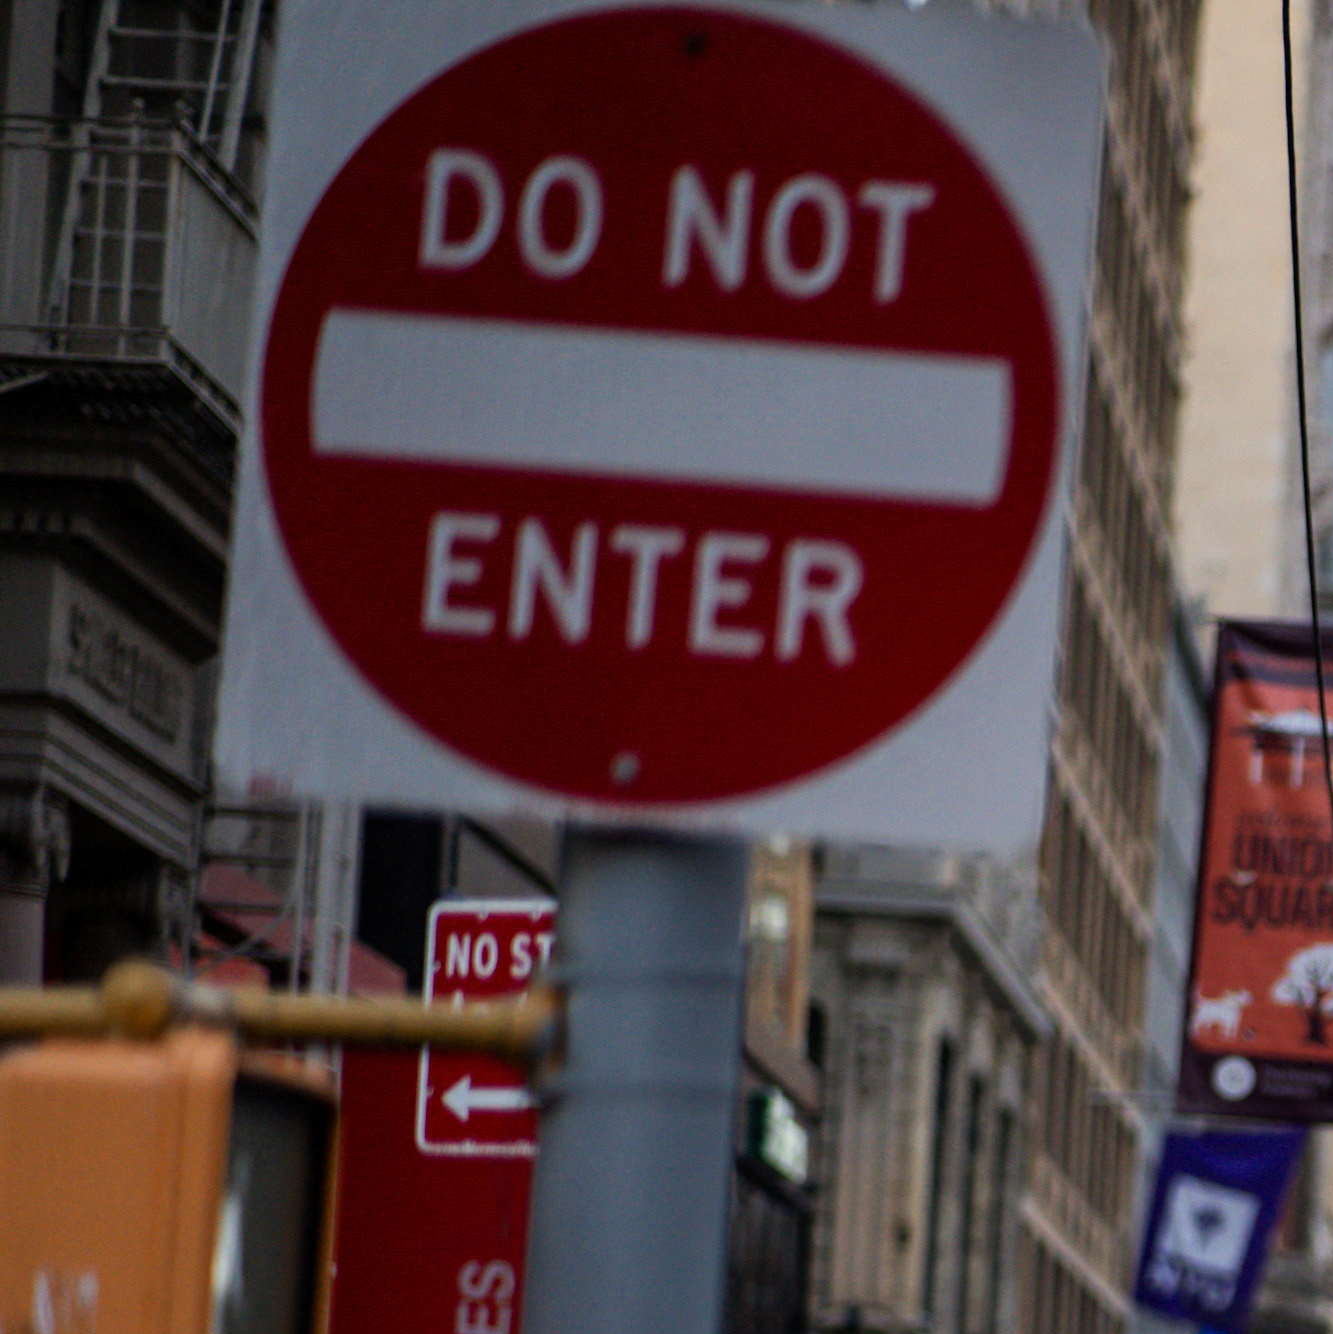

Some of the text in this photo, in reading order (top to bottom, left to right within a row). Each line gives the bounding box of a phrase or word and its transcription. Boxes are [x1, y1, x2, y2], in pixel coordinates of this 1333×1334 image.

[418, 147, 937, 306] DO NOT
[420, 511, 865, 668] ENTER
[444, 931, 499, 980] NO
